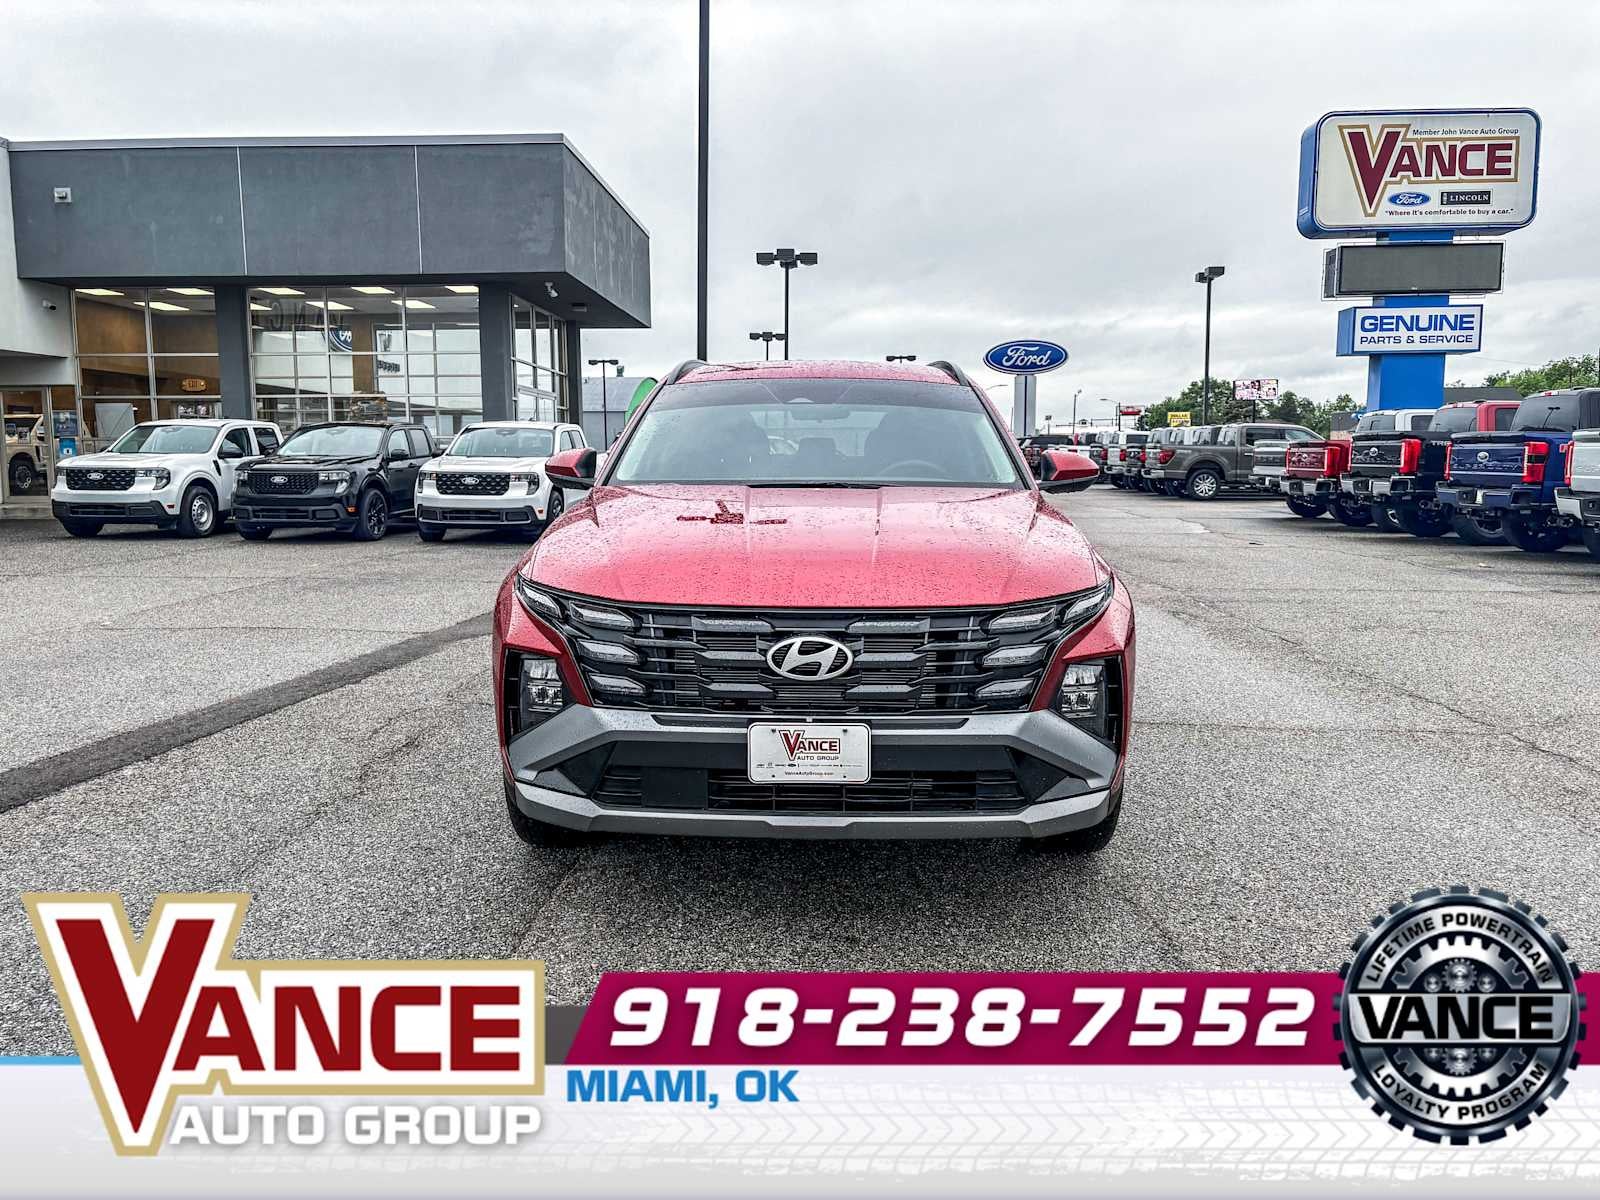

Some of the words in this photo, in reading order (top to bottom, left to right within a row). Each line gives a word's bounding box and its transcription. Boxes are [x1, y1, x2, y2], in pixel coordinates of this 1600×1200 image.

[1412, 128, 1440, 136] Member
[1441, 128, 1457, 136] John
[1498, 127, 1519, 135] Group
[1346, 130, 1513, 210] VANCE
[1396, 193, 1423, 204] Ford
[1449, 194, 1489, 202] LINCOLN
[1412, 208, 1422, 216] it's
[1424, 208, 1467, 216] comfortable
[1477, 207, 1489, 216] buy
[1360, 313, 1475, 333] GENUINE
[1360, 335, 1402, 345] PARTS
[1407, 335, 1415, 344] &
[1419, 334, 1473, 344] SERVICE
[1002, 345, 1052, 366] Ford
[782, 732, 838, 758] VANCE
